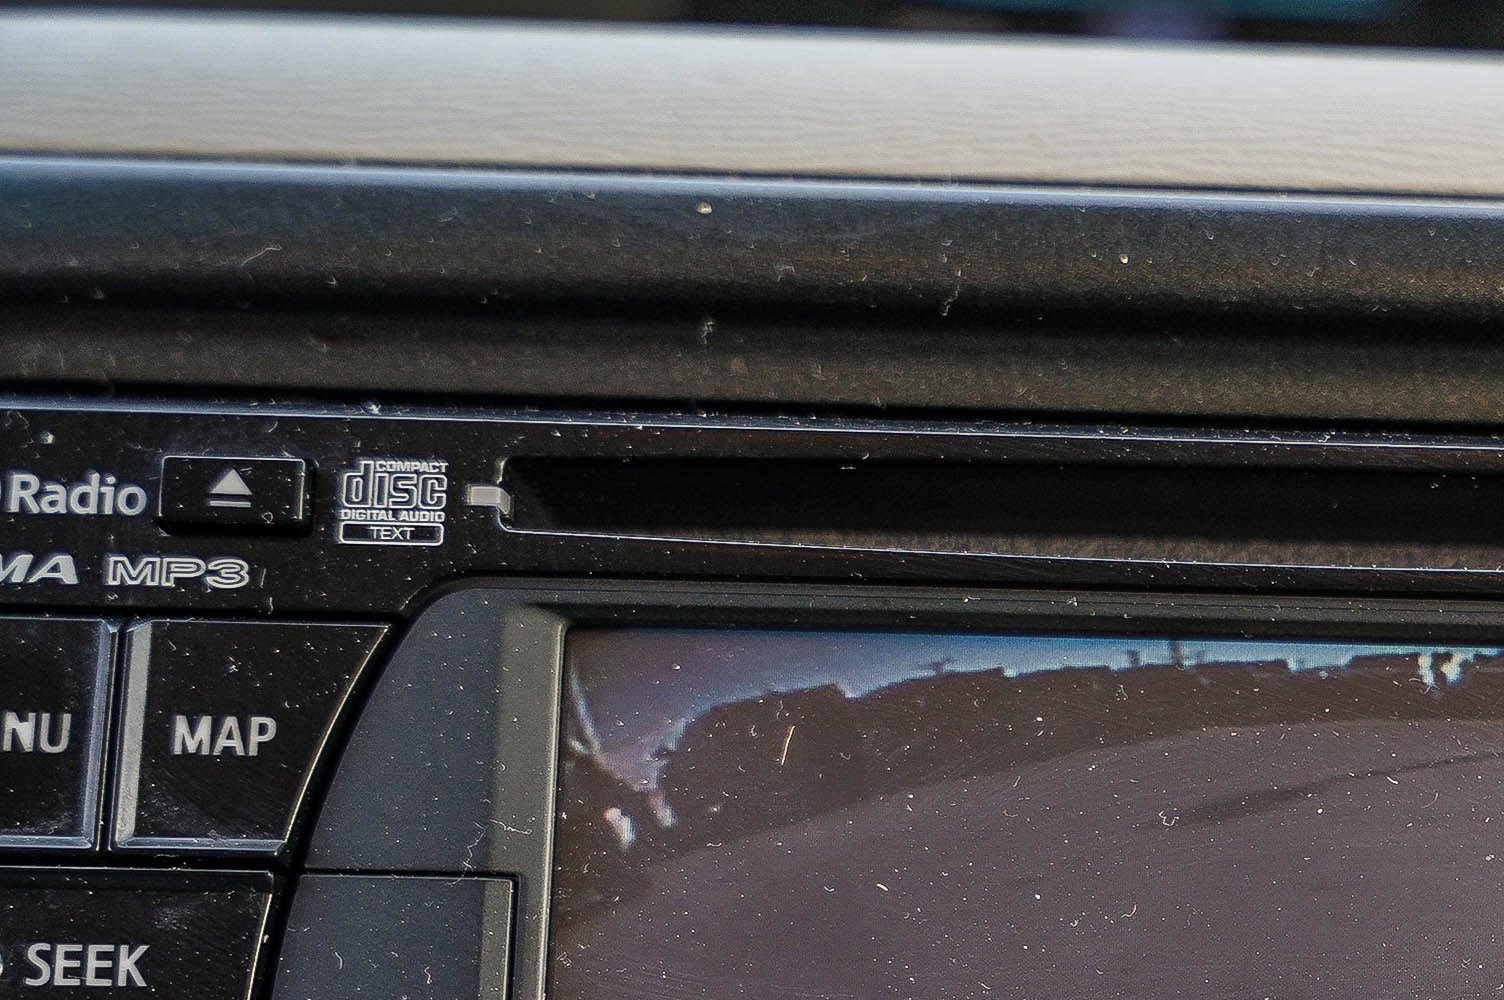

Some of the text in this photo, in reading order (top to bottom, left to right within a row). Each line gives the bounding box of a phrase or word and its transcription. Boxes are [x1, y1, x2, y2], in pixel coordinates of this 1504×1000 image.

[375, 461, 448, 473] COMPACT
[8, 471, 147, 516] Radio
[340, 509, 446, 522] DIGITAL AUDIO
[368, 525, 415, 540] TEXT
[106, 556, 250, 589] MP3
[2, 711, 72, 754] NU
[172, 714, 278, 757] MAP
[24, 942, 149, 988] SEEK
